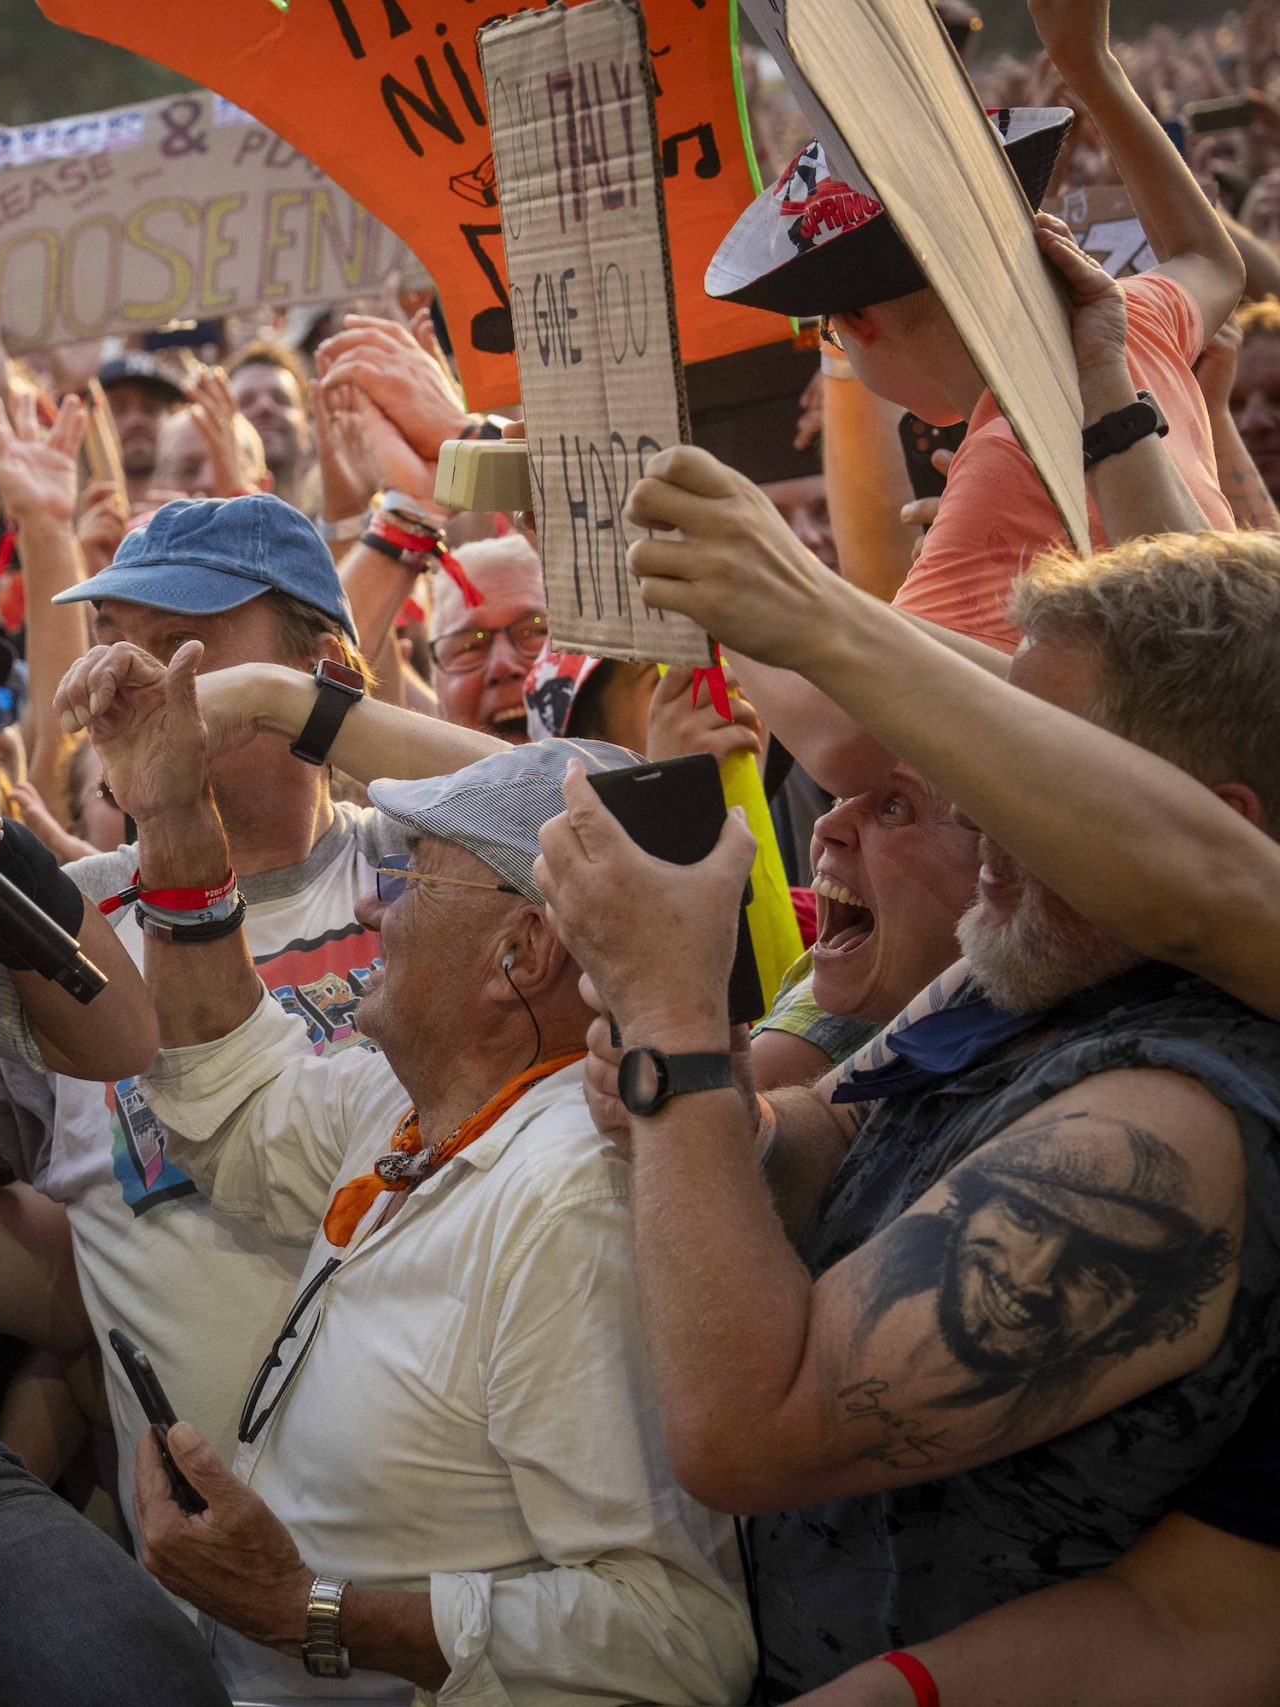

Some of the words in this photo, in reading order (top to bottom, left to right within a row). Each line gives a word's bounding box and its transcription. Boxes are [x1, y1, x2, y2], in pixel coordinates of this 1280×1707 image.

[159, 97, 208, 158] &
[545, 61, 638, 234] ITALY
[533, 267, 583, 370] GIVE
[597, 262, 648, 364] YOU
